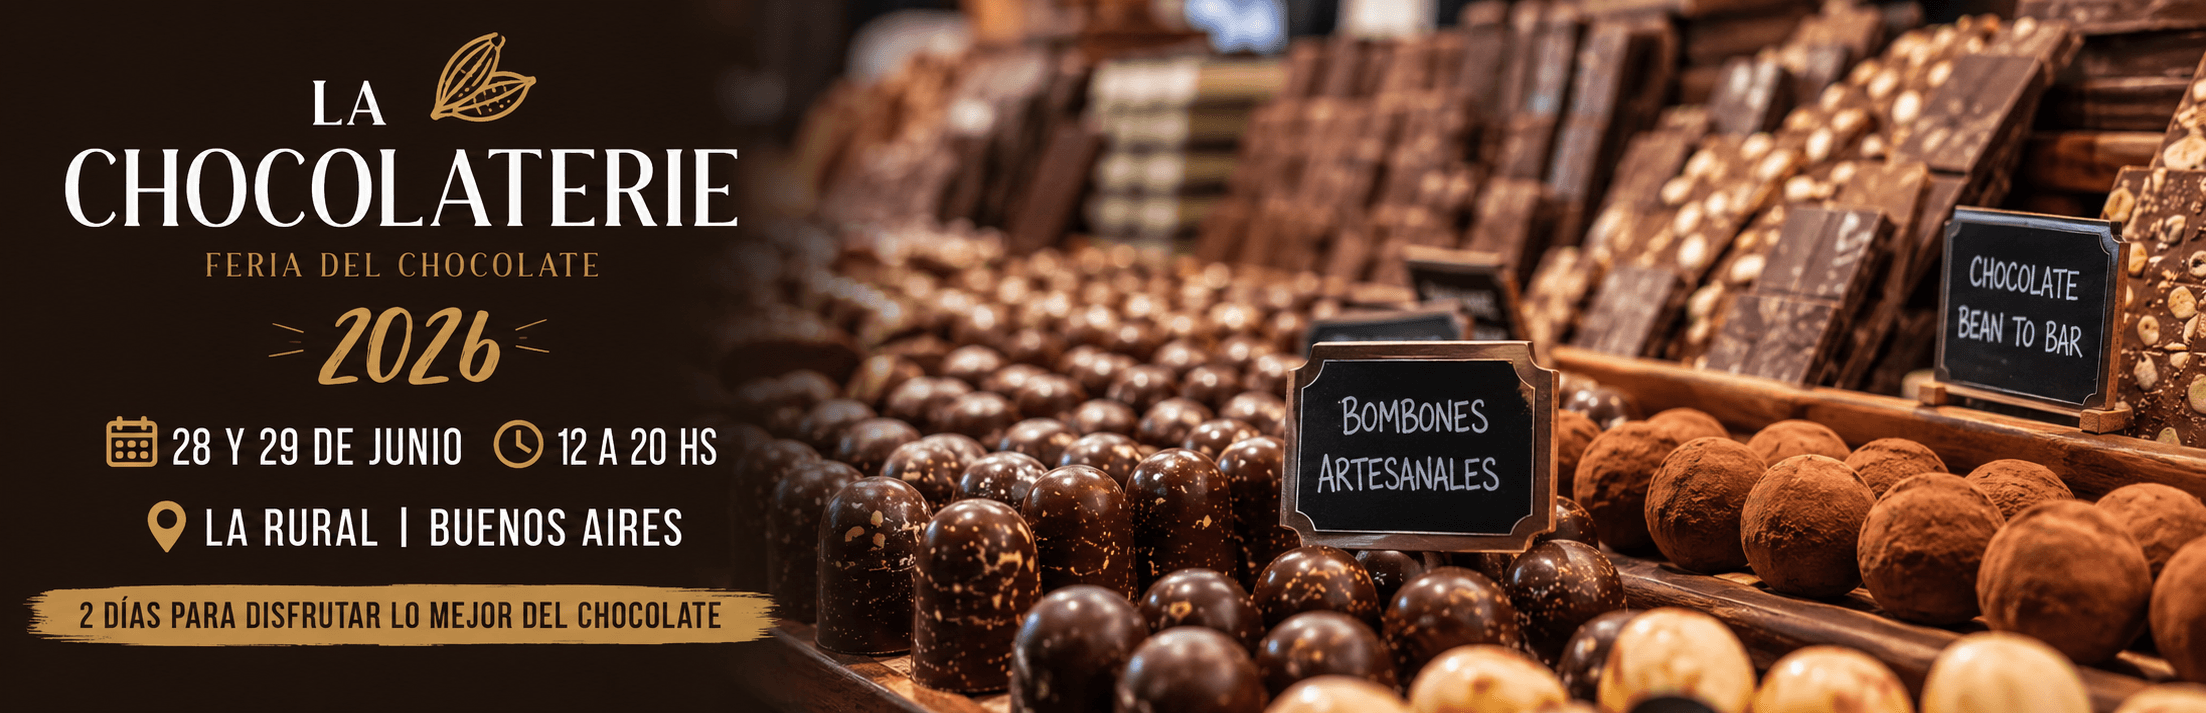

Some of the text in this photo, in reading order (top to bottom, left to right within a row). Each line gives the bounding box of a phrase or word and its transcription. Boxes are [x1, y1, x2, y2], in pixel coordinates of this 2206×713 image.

[1970, 255, 2079, 300] CHOCOLATE
[1958, 305, 2082, 358] BEAN TO BAR
[1342, 396, 1488, 435] BOMBONES
[1318, 454, 1499, 493] ARTESANALES
